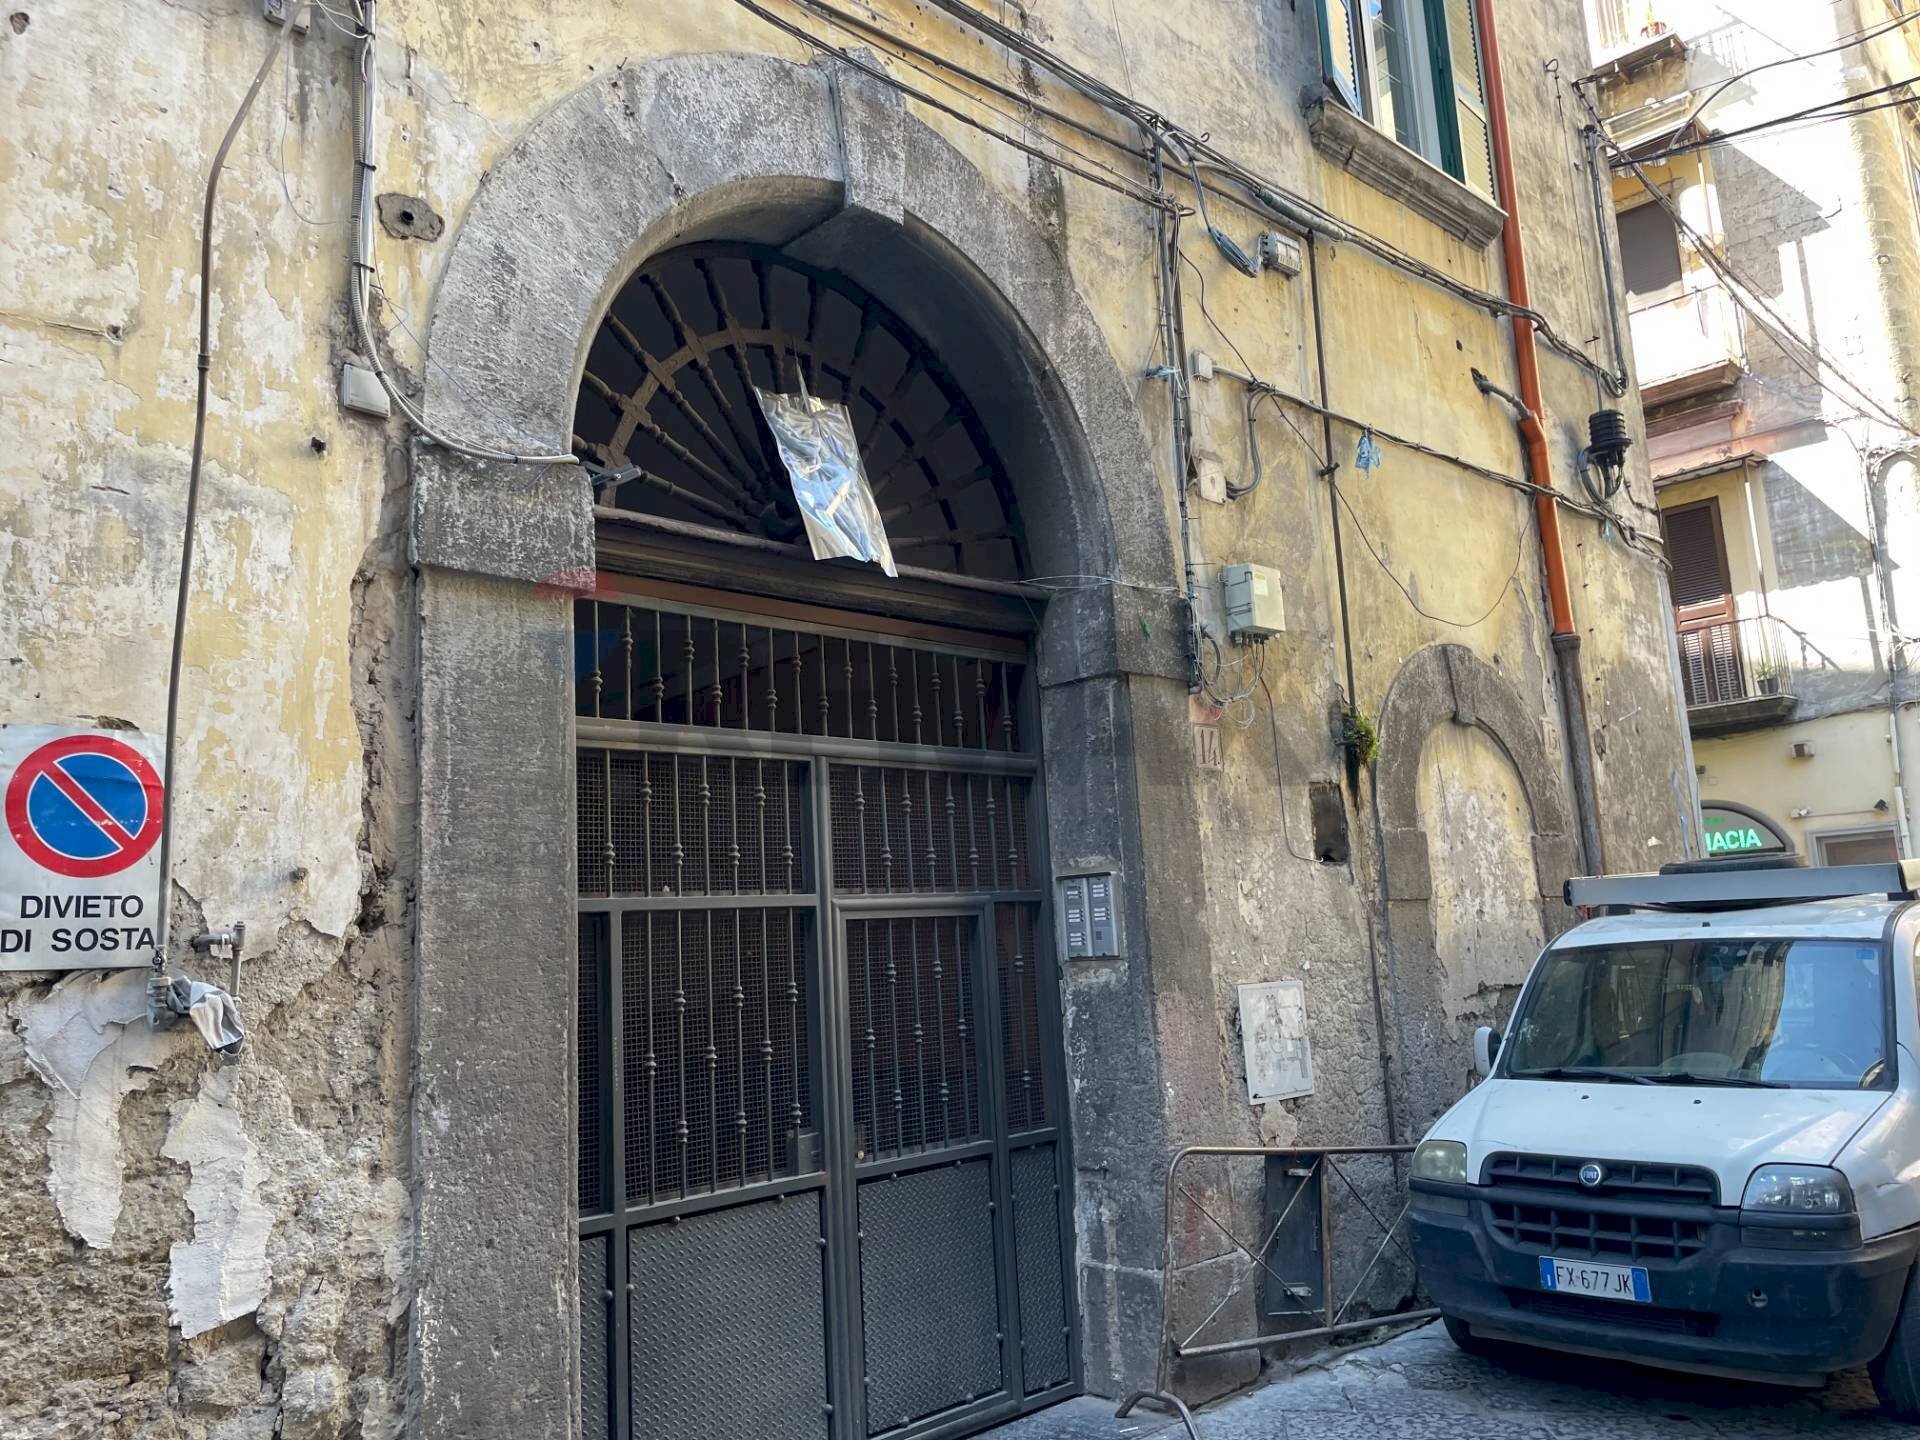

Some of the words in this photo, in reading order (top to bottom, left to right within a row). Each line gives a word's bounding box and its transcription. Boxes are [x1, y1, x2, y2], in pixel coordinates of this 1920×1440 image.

[20, 895, 144, 918] DIVIETO
[0, 929, 31, 952] DI
[51, 928, 155, 952] SOSTA
[1580, 1270, 1609, 1292] 677
[1614, 1274, 1632, 1293] JK
